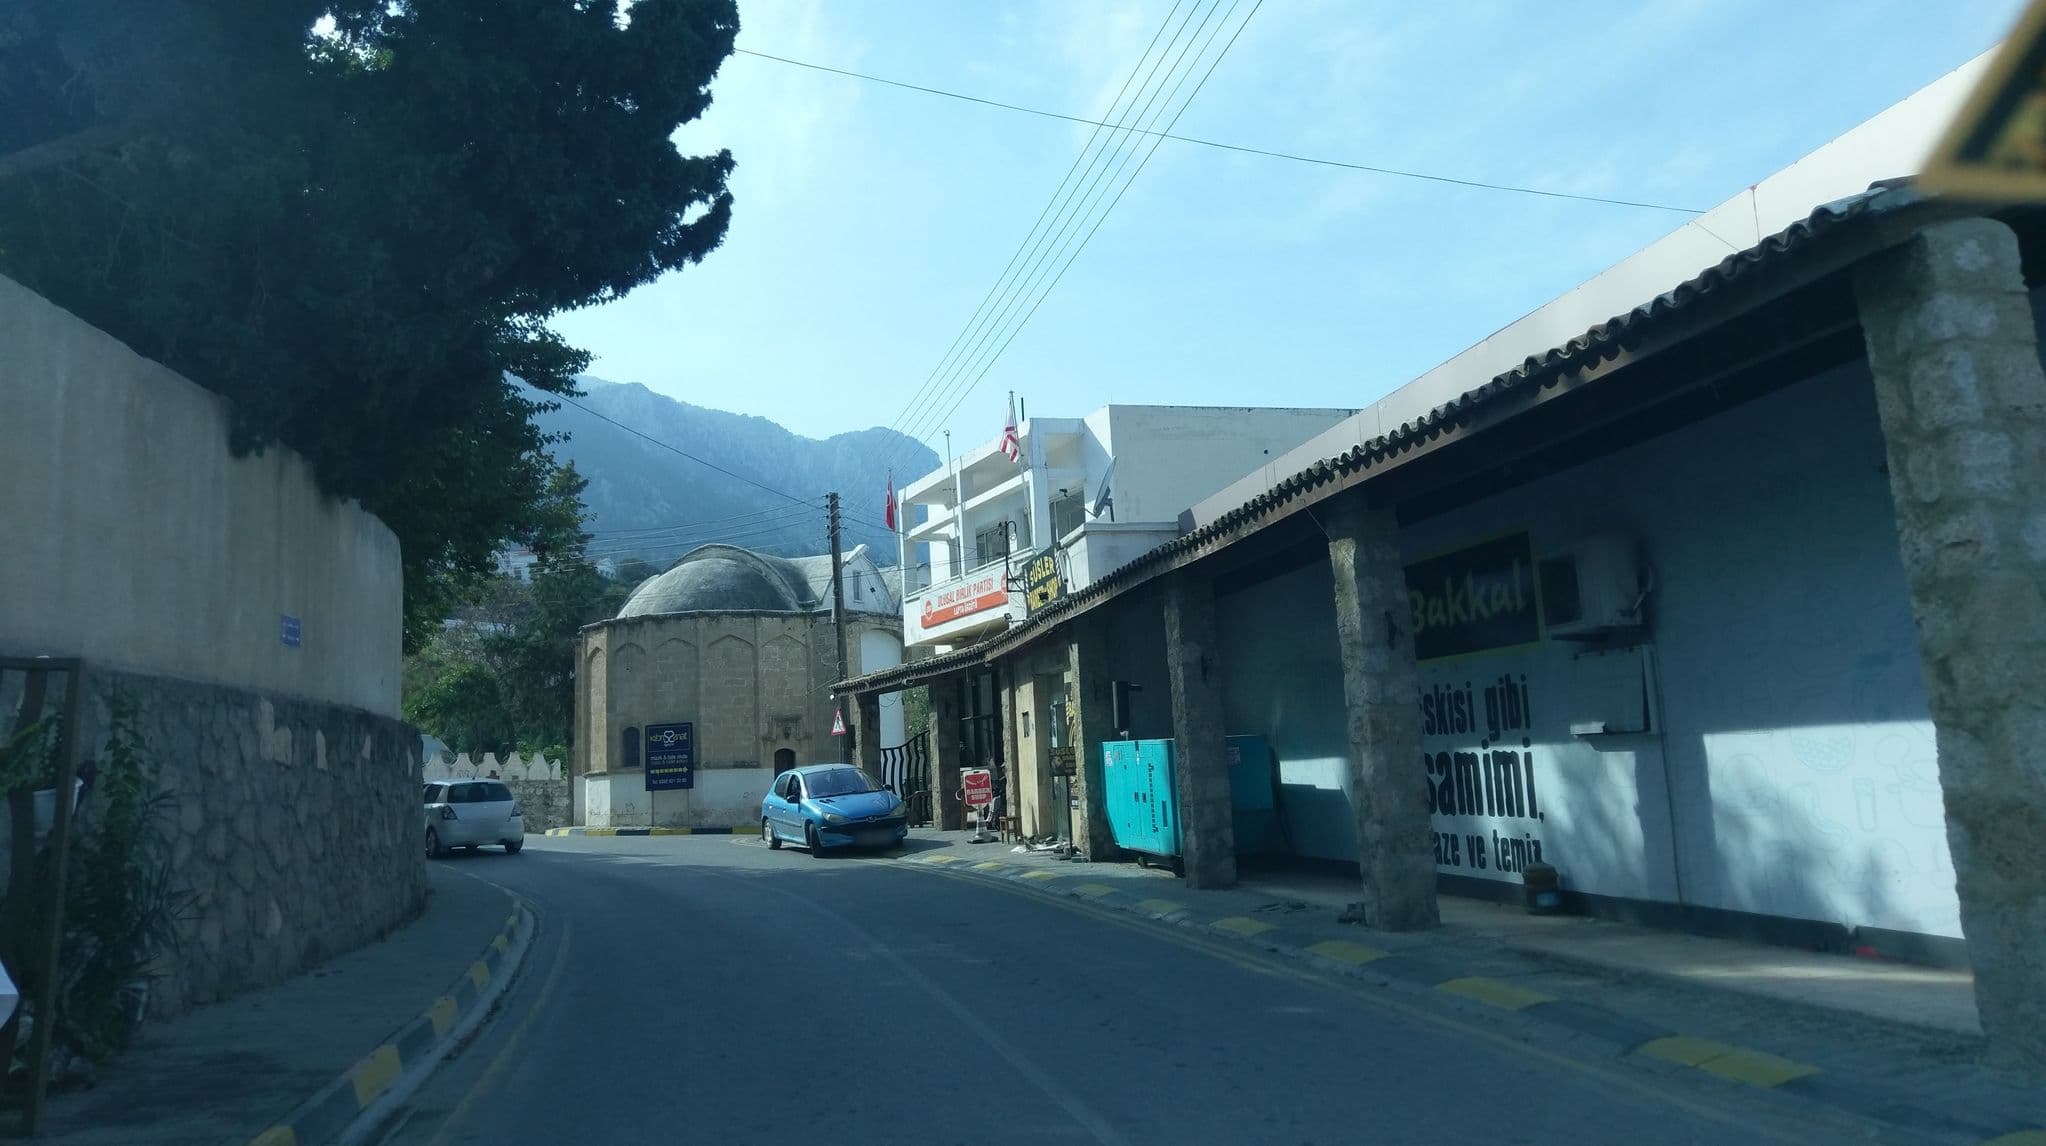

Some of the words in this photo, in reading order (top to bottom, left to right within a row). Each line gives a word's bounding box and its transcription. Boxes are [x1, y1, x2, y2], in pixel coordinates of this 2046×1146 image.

[1418, 681, 1476, 736] skisi
[1485, 673, 1531, 742] gibi
[1433, 831, 1460, 867] aze
[1465, 833, 1487, 869] ve
